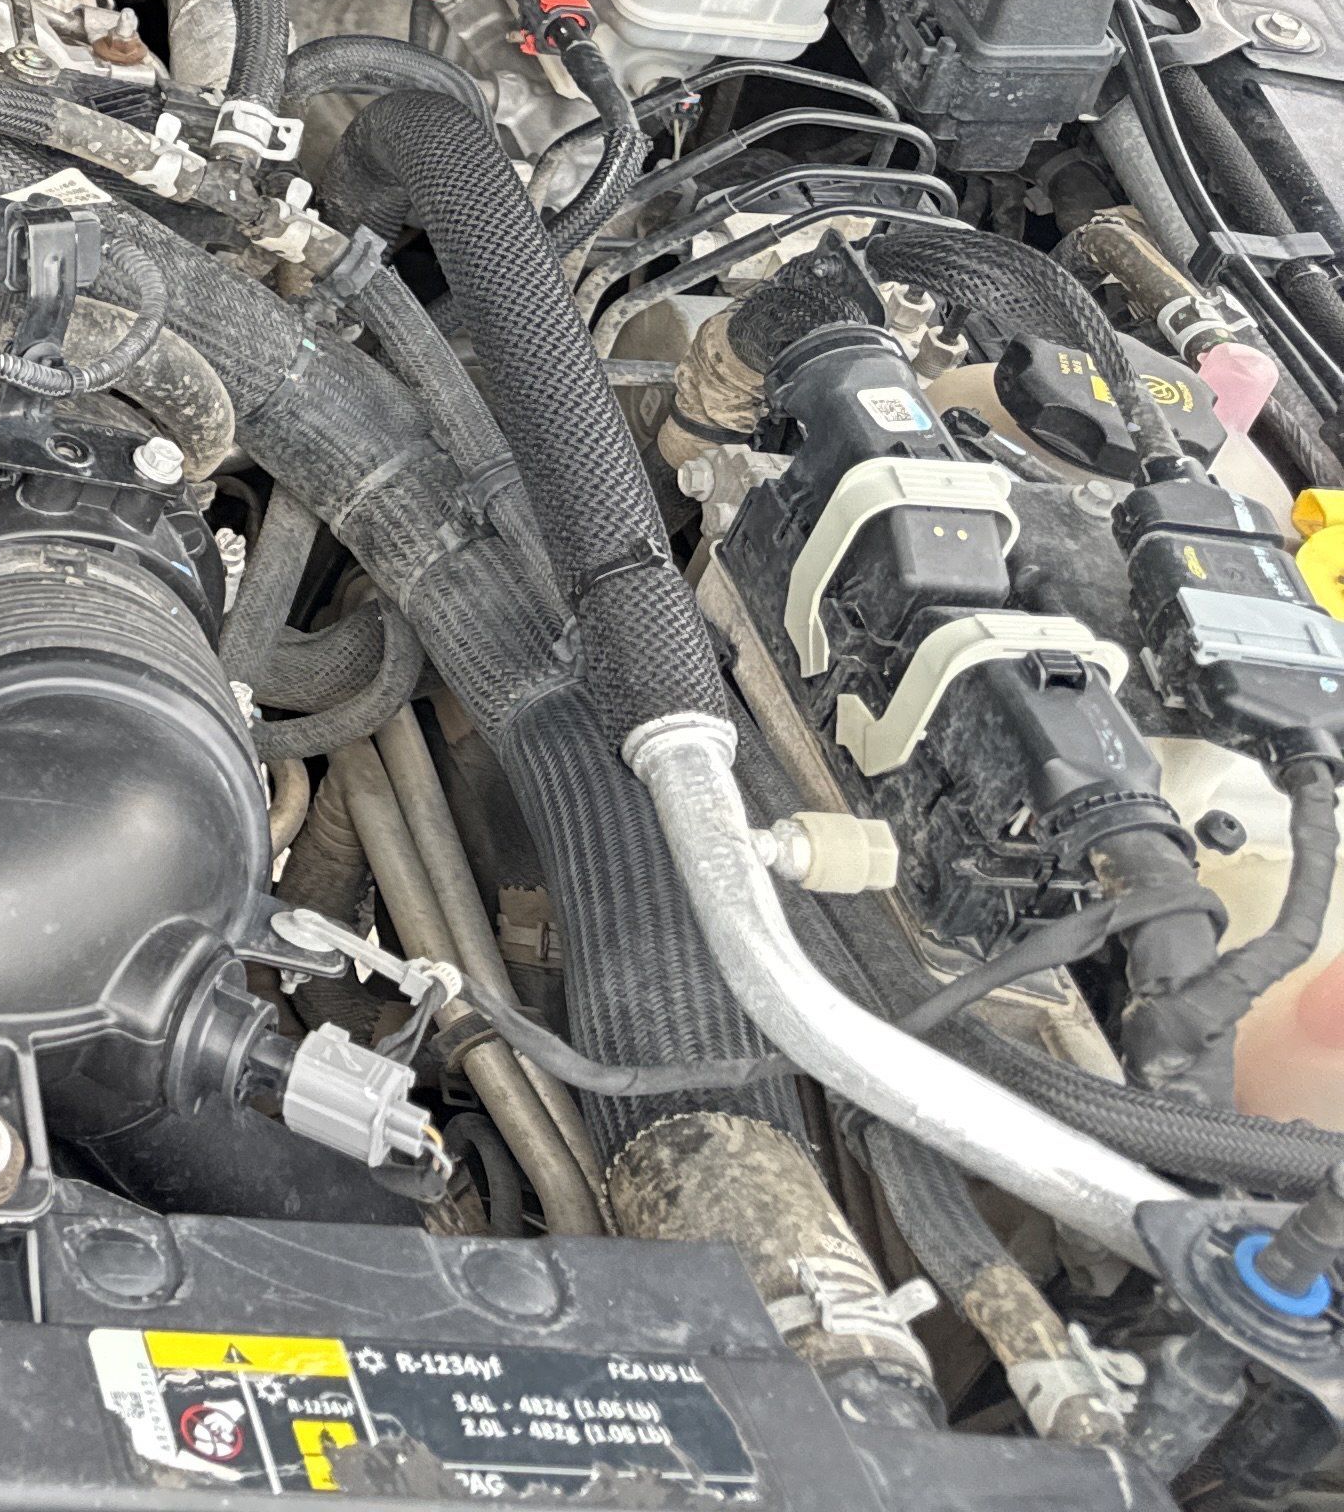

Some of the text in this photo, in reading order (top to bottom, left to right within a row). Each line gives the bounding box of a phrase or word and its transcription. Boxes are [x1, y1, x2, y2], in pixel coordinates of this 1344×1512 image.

[395, 1352, 504, 1381] R-1234yf
[607, 1361, 650, 1382] FCA
[651, 1363, 679, 1383] US
[287, 1397, 356, 1417] R-1234yf
[518, 1395, 571, 1420] 482g
[528, 1420, 581, 1445] 482g
